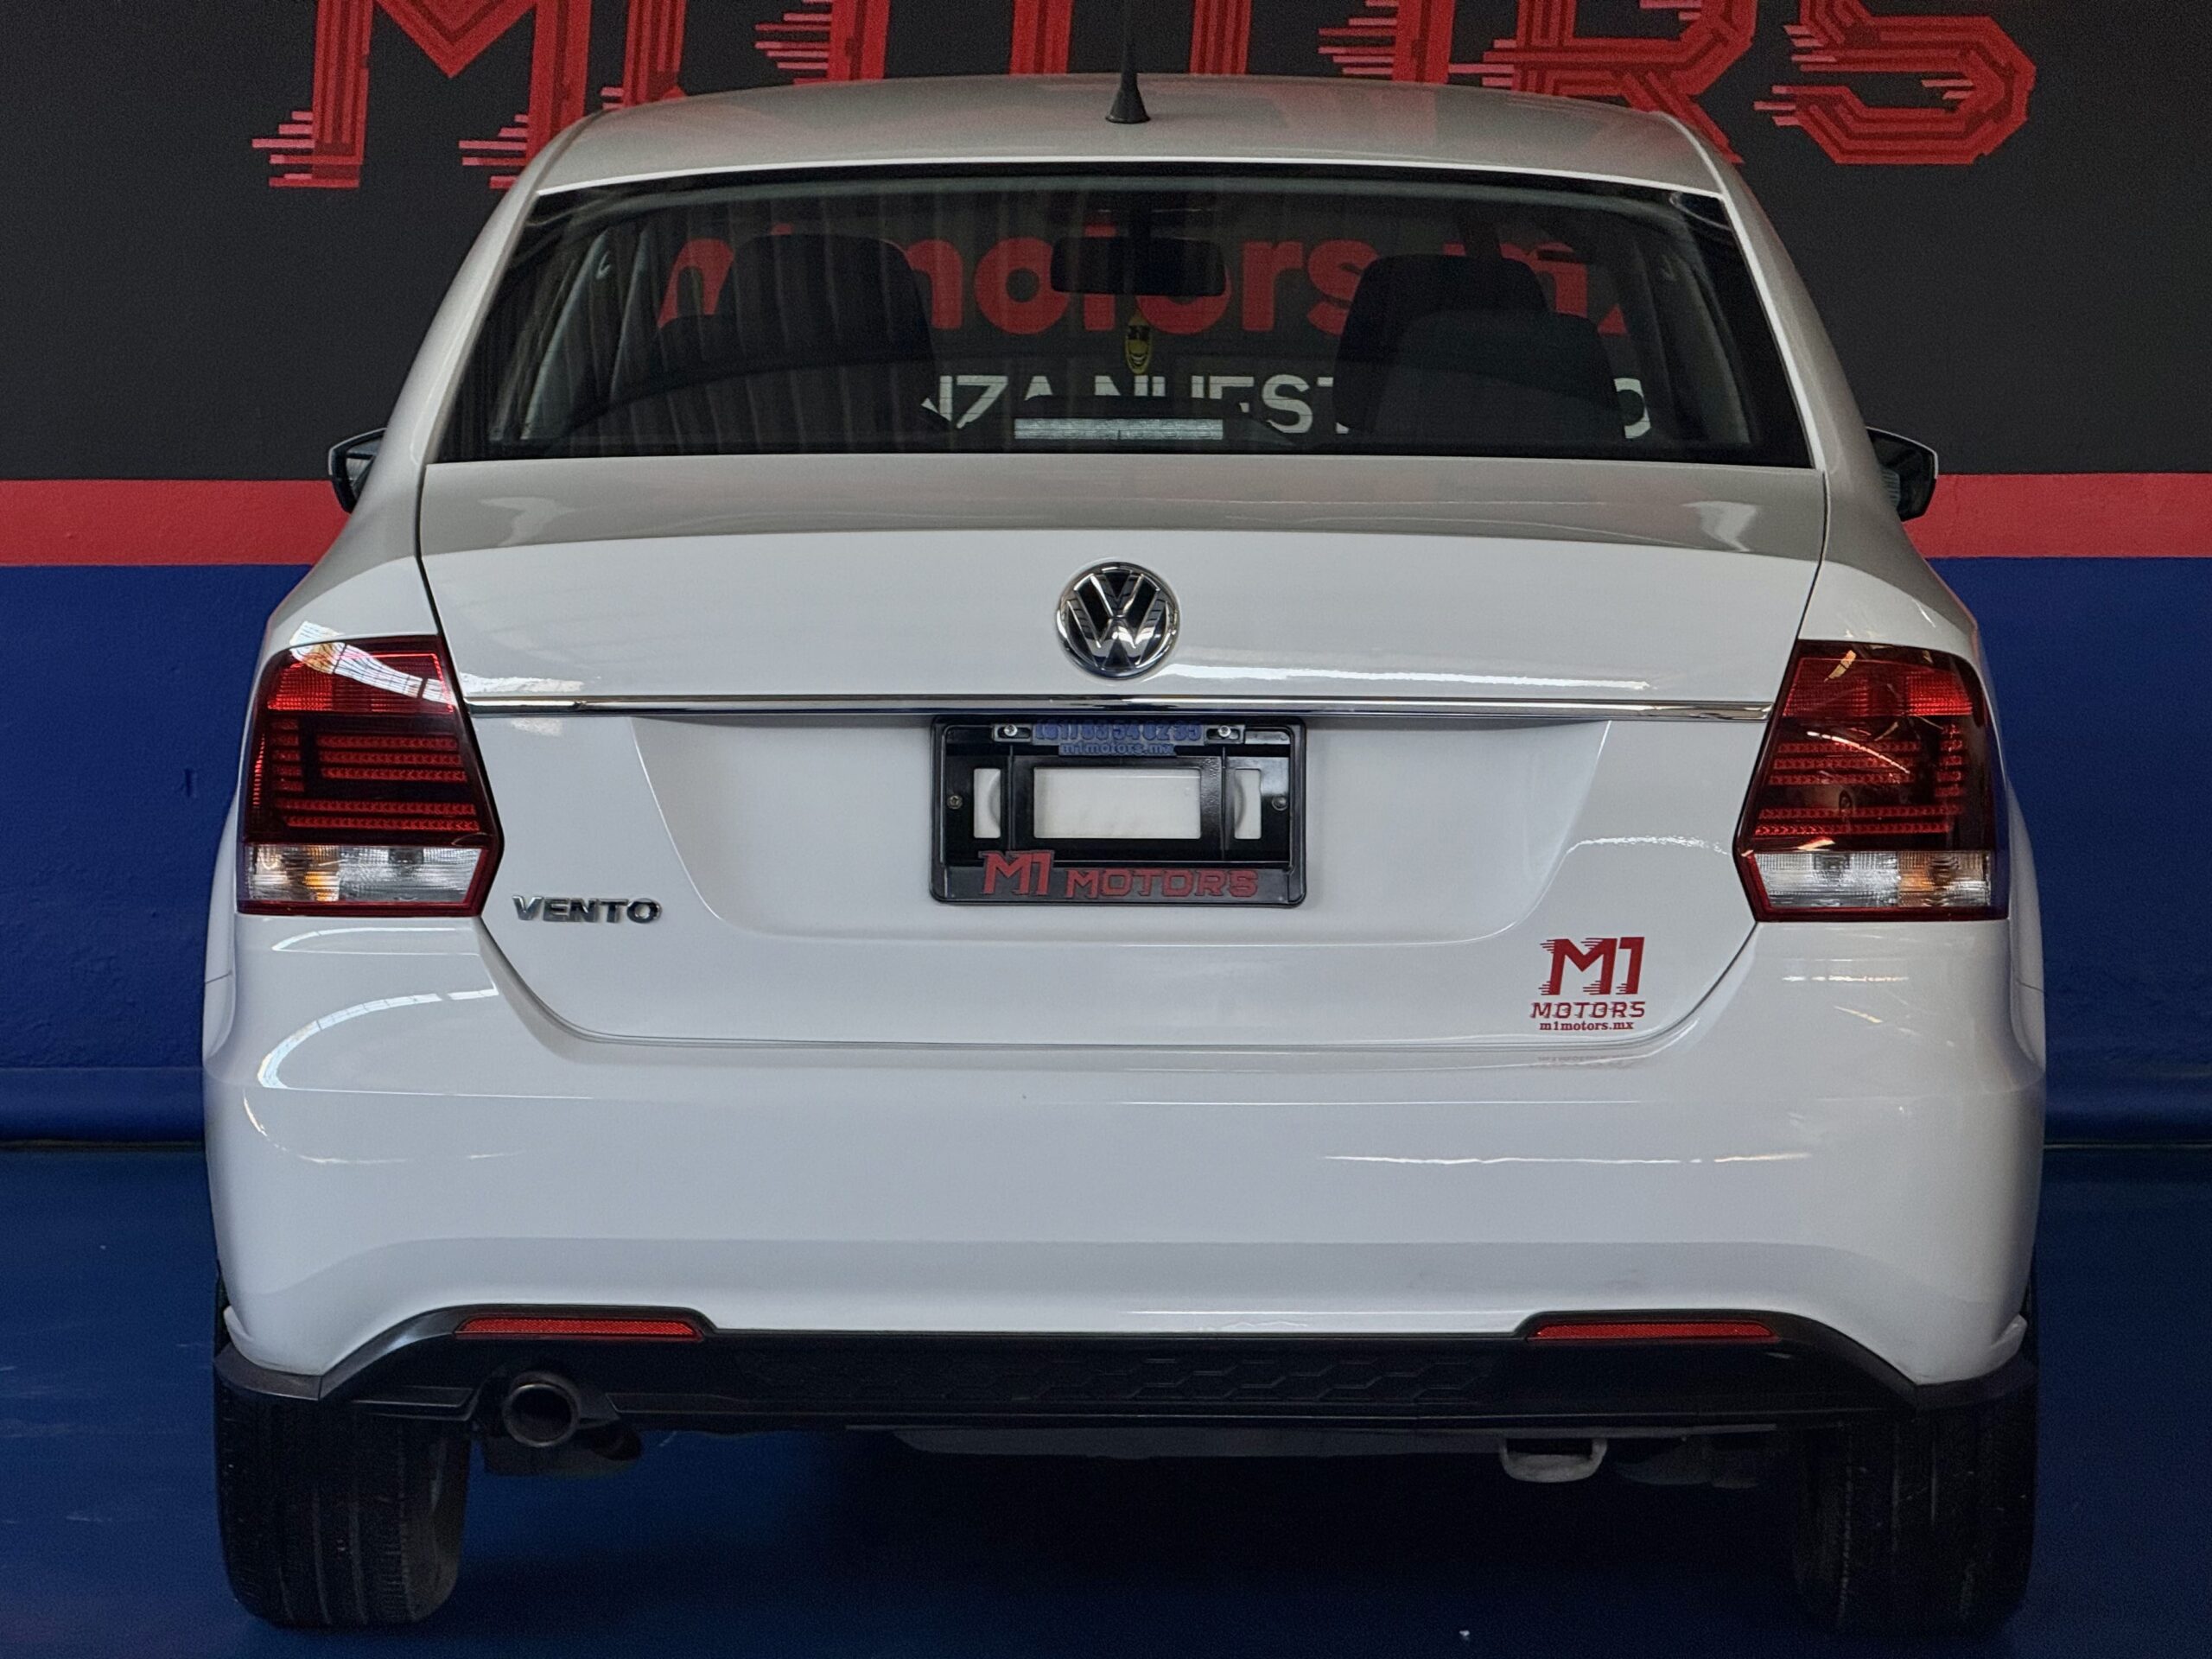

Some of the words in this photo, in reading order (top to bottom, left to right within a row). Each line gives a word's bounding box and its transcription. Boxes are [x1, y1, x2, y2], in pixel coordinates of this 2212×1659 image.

[981, 851, 1053, 896] M1
[1065, 868, 1259, 899] MOTORS
[512, 895, 662, 925] VENTO
[1538, 937, 1645, 995] M1
[1529, 1001, 1646, 1019] MOTORS
[1539, 1020, 1635, 1031] m1motors.mx
